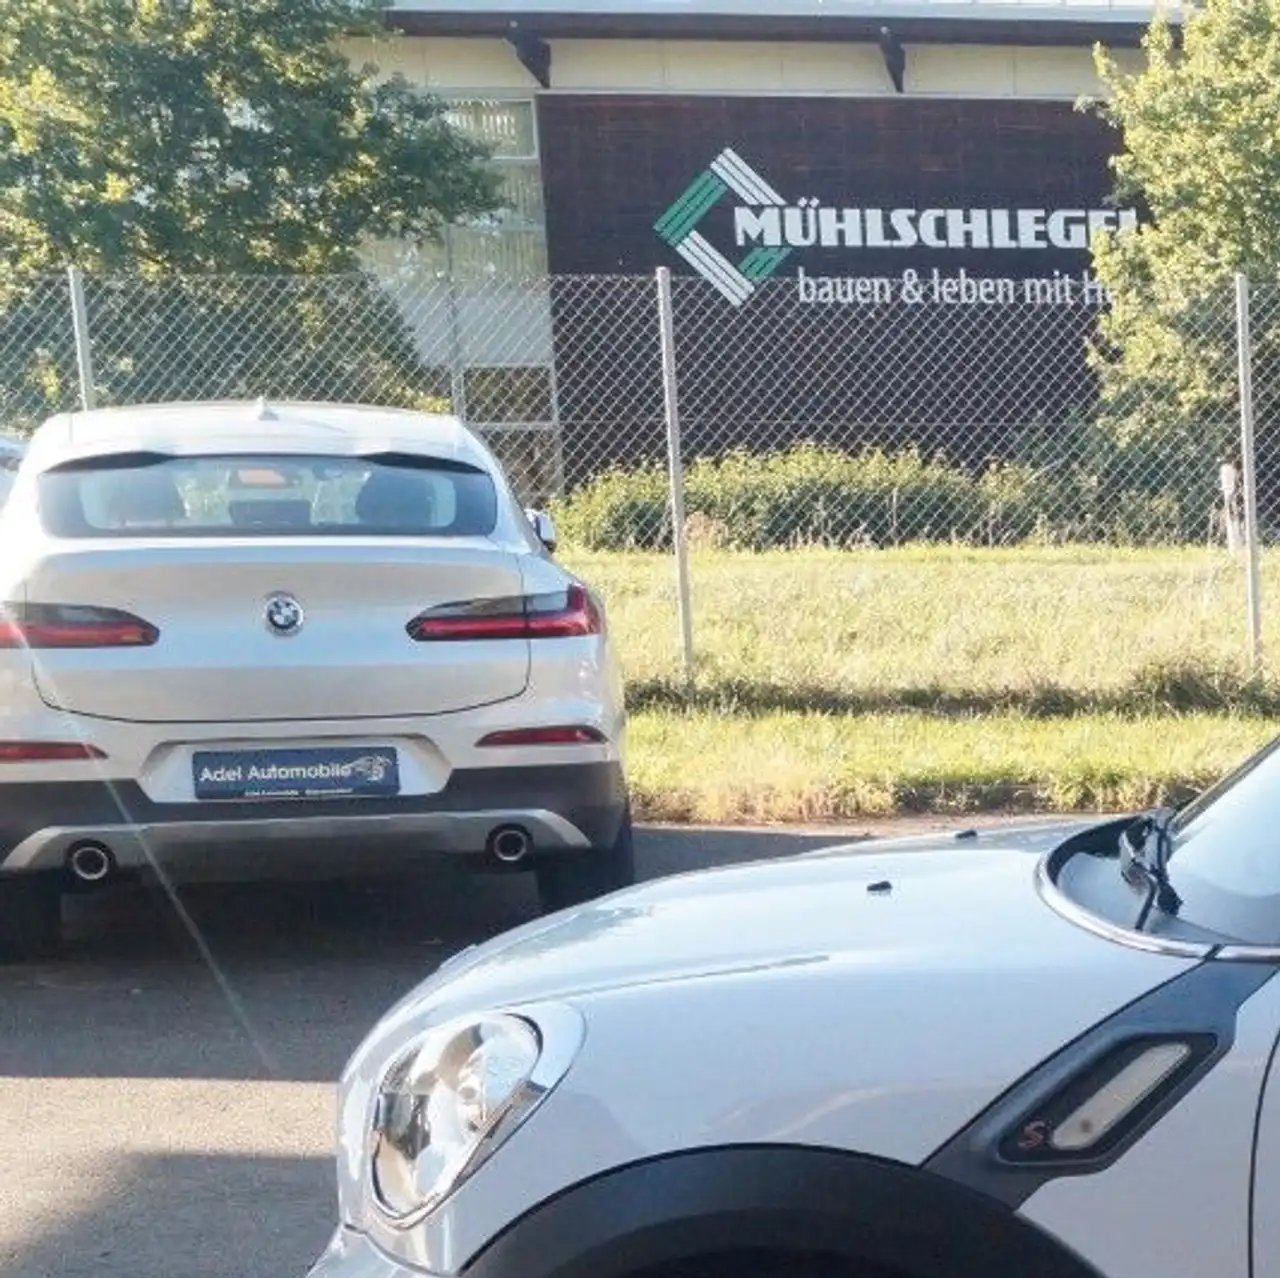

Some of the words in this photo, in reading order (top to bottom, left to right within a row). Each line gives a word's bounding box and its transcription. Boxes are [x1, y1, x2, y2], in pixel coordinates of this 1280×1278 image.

[798, 268, 890, 303] bauen
[901, 271, 924, 303] &
[933, 269, 1015, 303] leben
[1024, 269, 1073, 304] mit
[200, 767, 241, 782] Adel
[248, 763, 351, 780] Automobile
